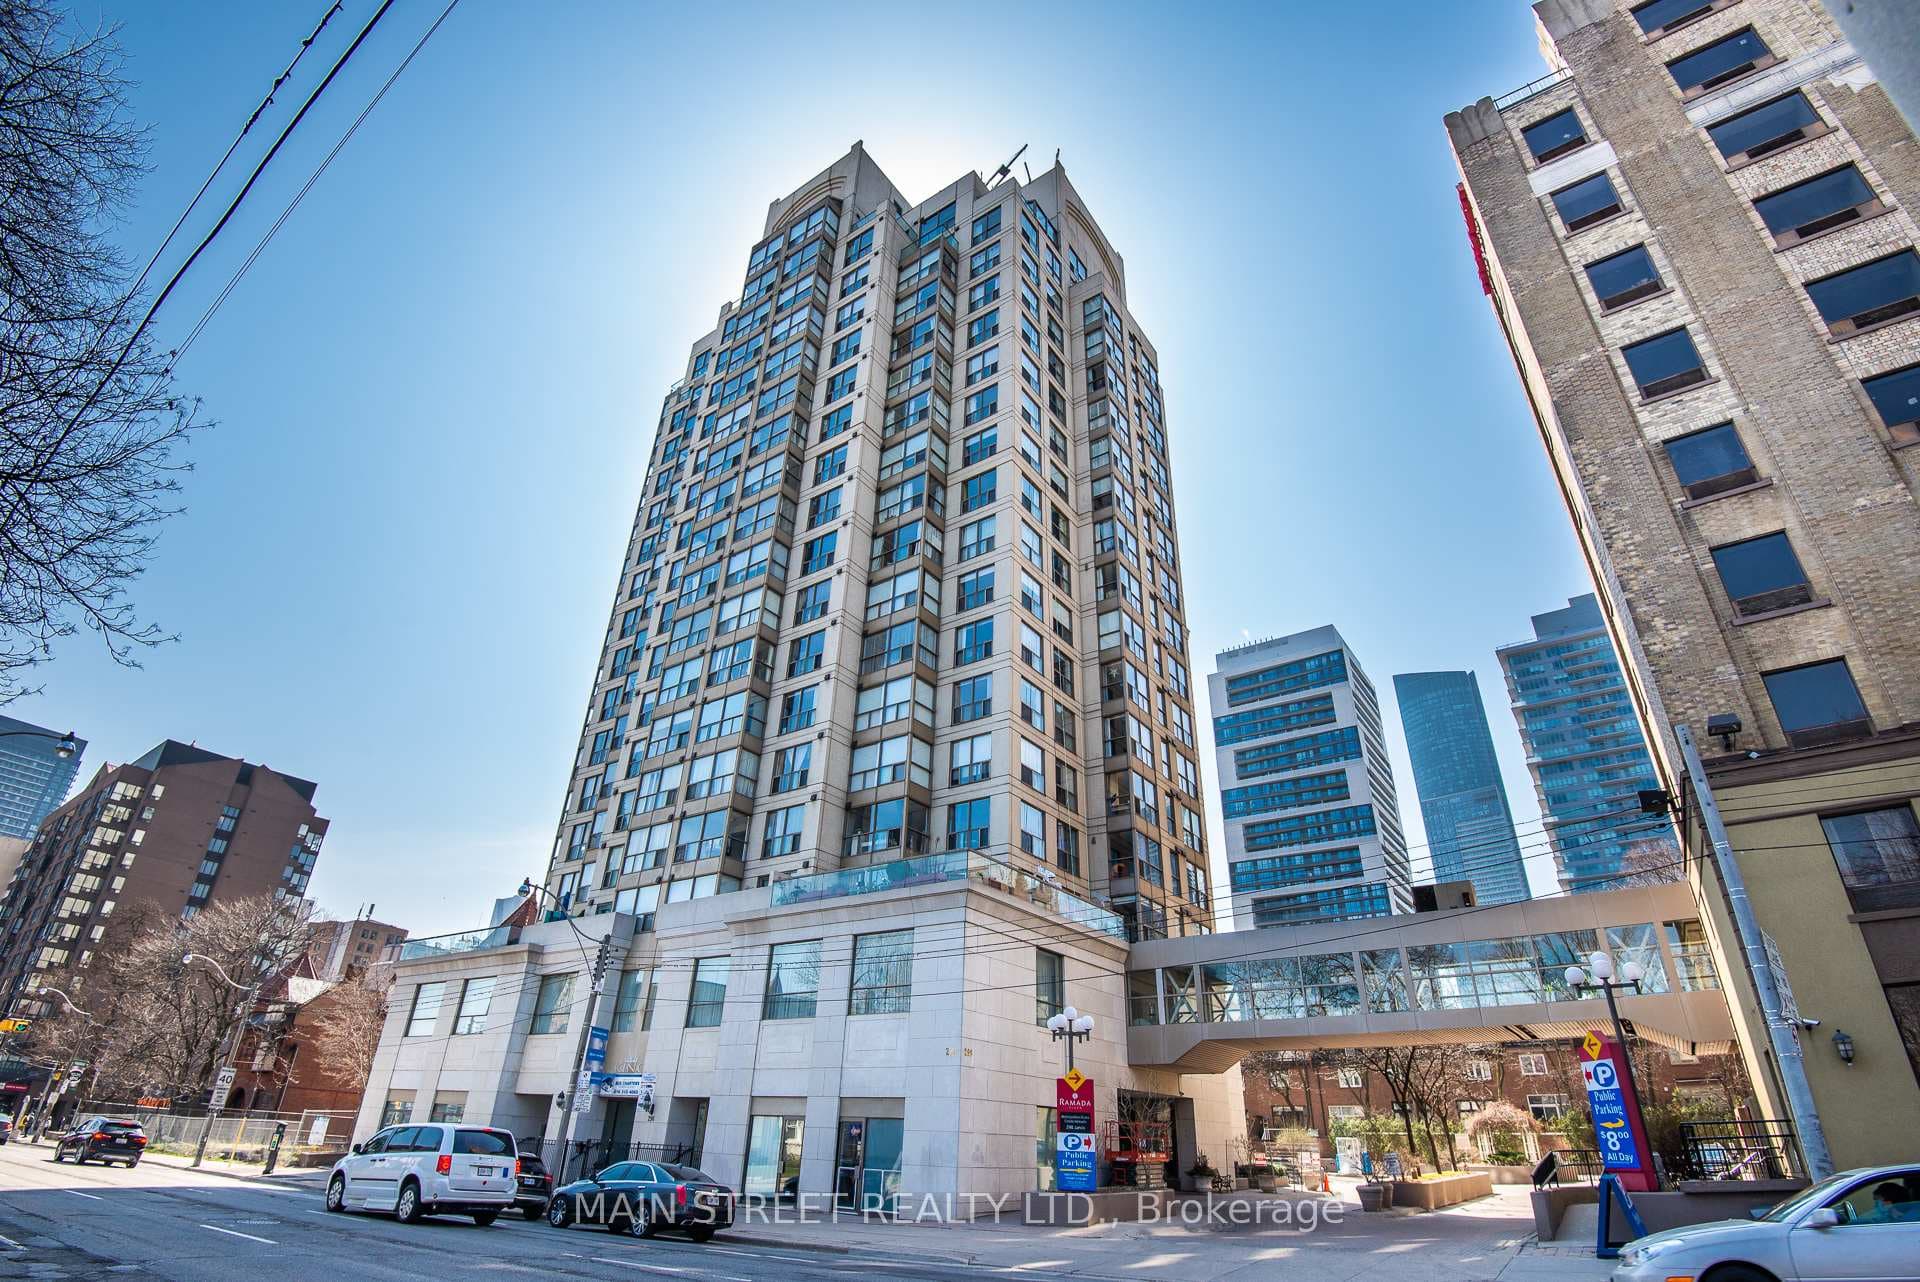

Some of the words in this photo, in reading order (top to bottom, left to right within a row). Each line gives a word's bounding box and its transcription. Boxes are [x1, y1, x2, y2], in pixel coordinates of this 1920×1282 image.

[219, 1074, 233, 1084] 40
[1596, 1066, 1612, 1084] P
[1594, 1089, 1616, 1102] Public
[1059, 1098, 1092, 1107] RAMADA
[1594, 1104, 1624, 1116] Parking
[1067, 1136, 1080, 1148] P
[1065, 1151, 1089, 1159] Public
[1607, 1152, 1617, 1161] All
[1619, 1152, 1634, 1163] Day
[1062, 1159, 1092, 1168] Parking
